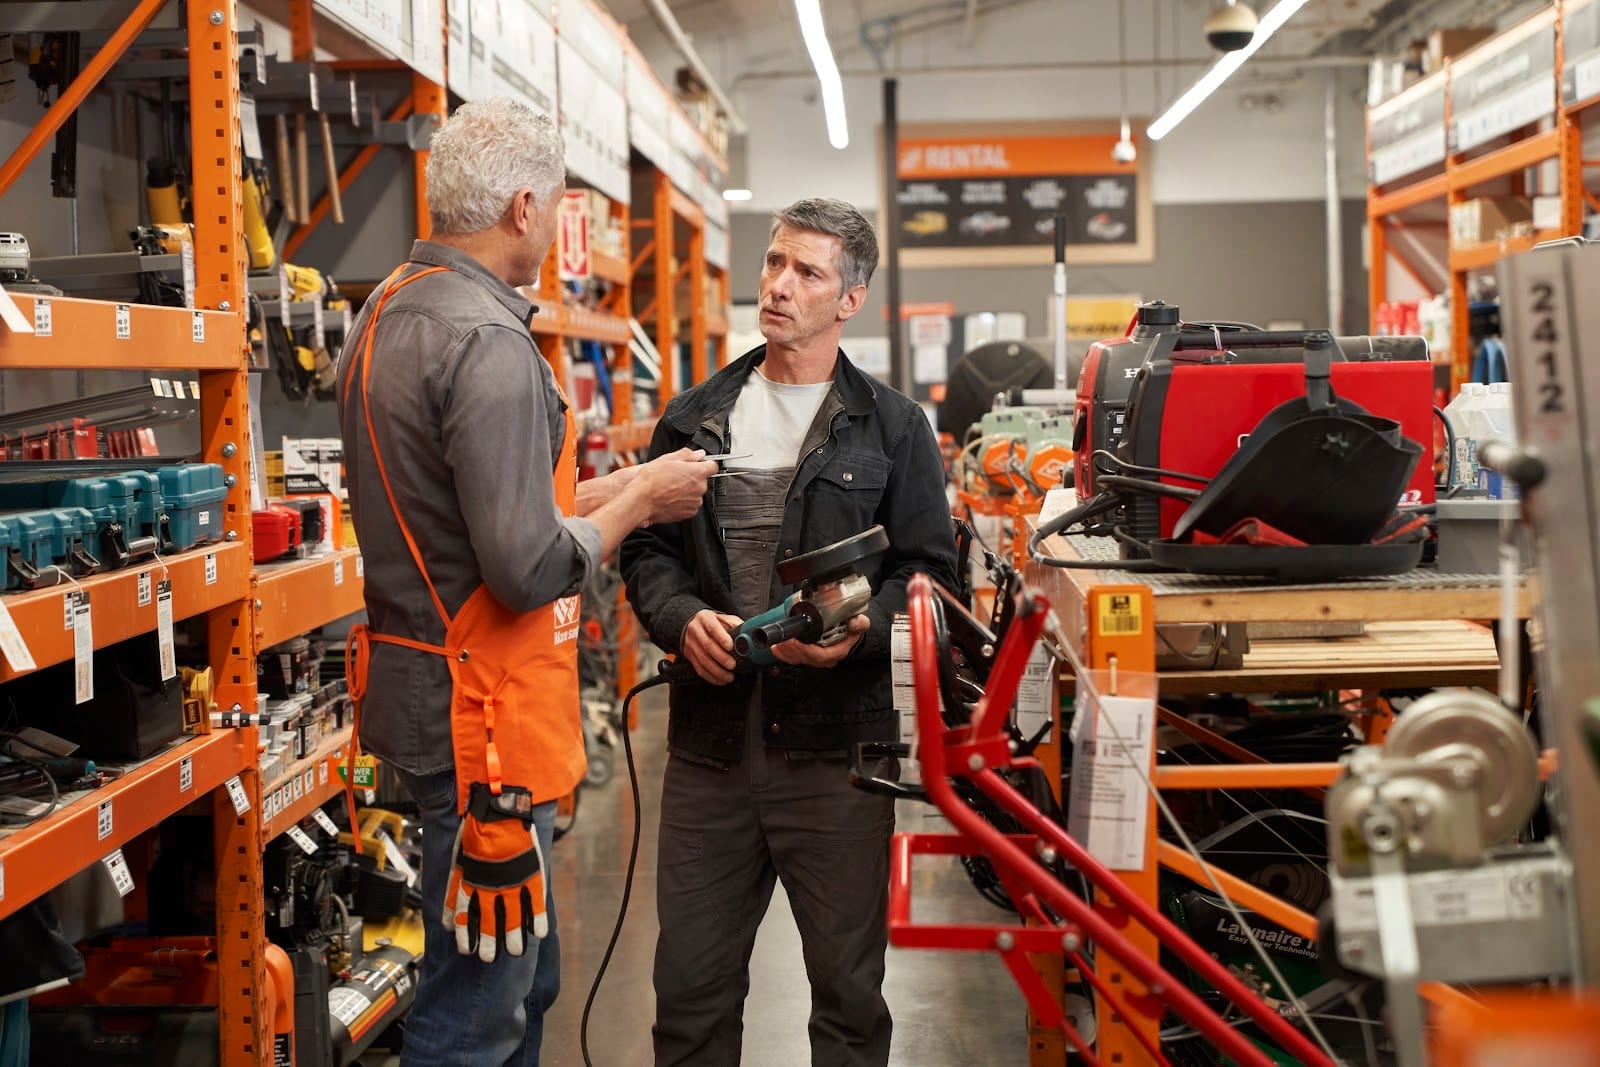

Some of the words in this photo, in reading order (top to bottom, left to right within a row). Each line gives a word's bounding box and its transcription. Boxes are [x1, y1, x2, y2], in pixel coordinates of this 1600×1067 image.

[925, 145, 1010, 169] RENTAL
[343, 766, 371, 776] LWER
[1228, 933, 1249, 945] Easy
